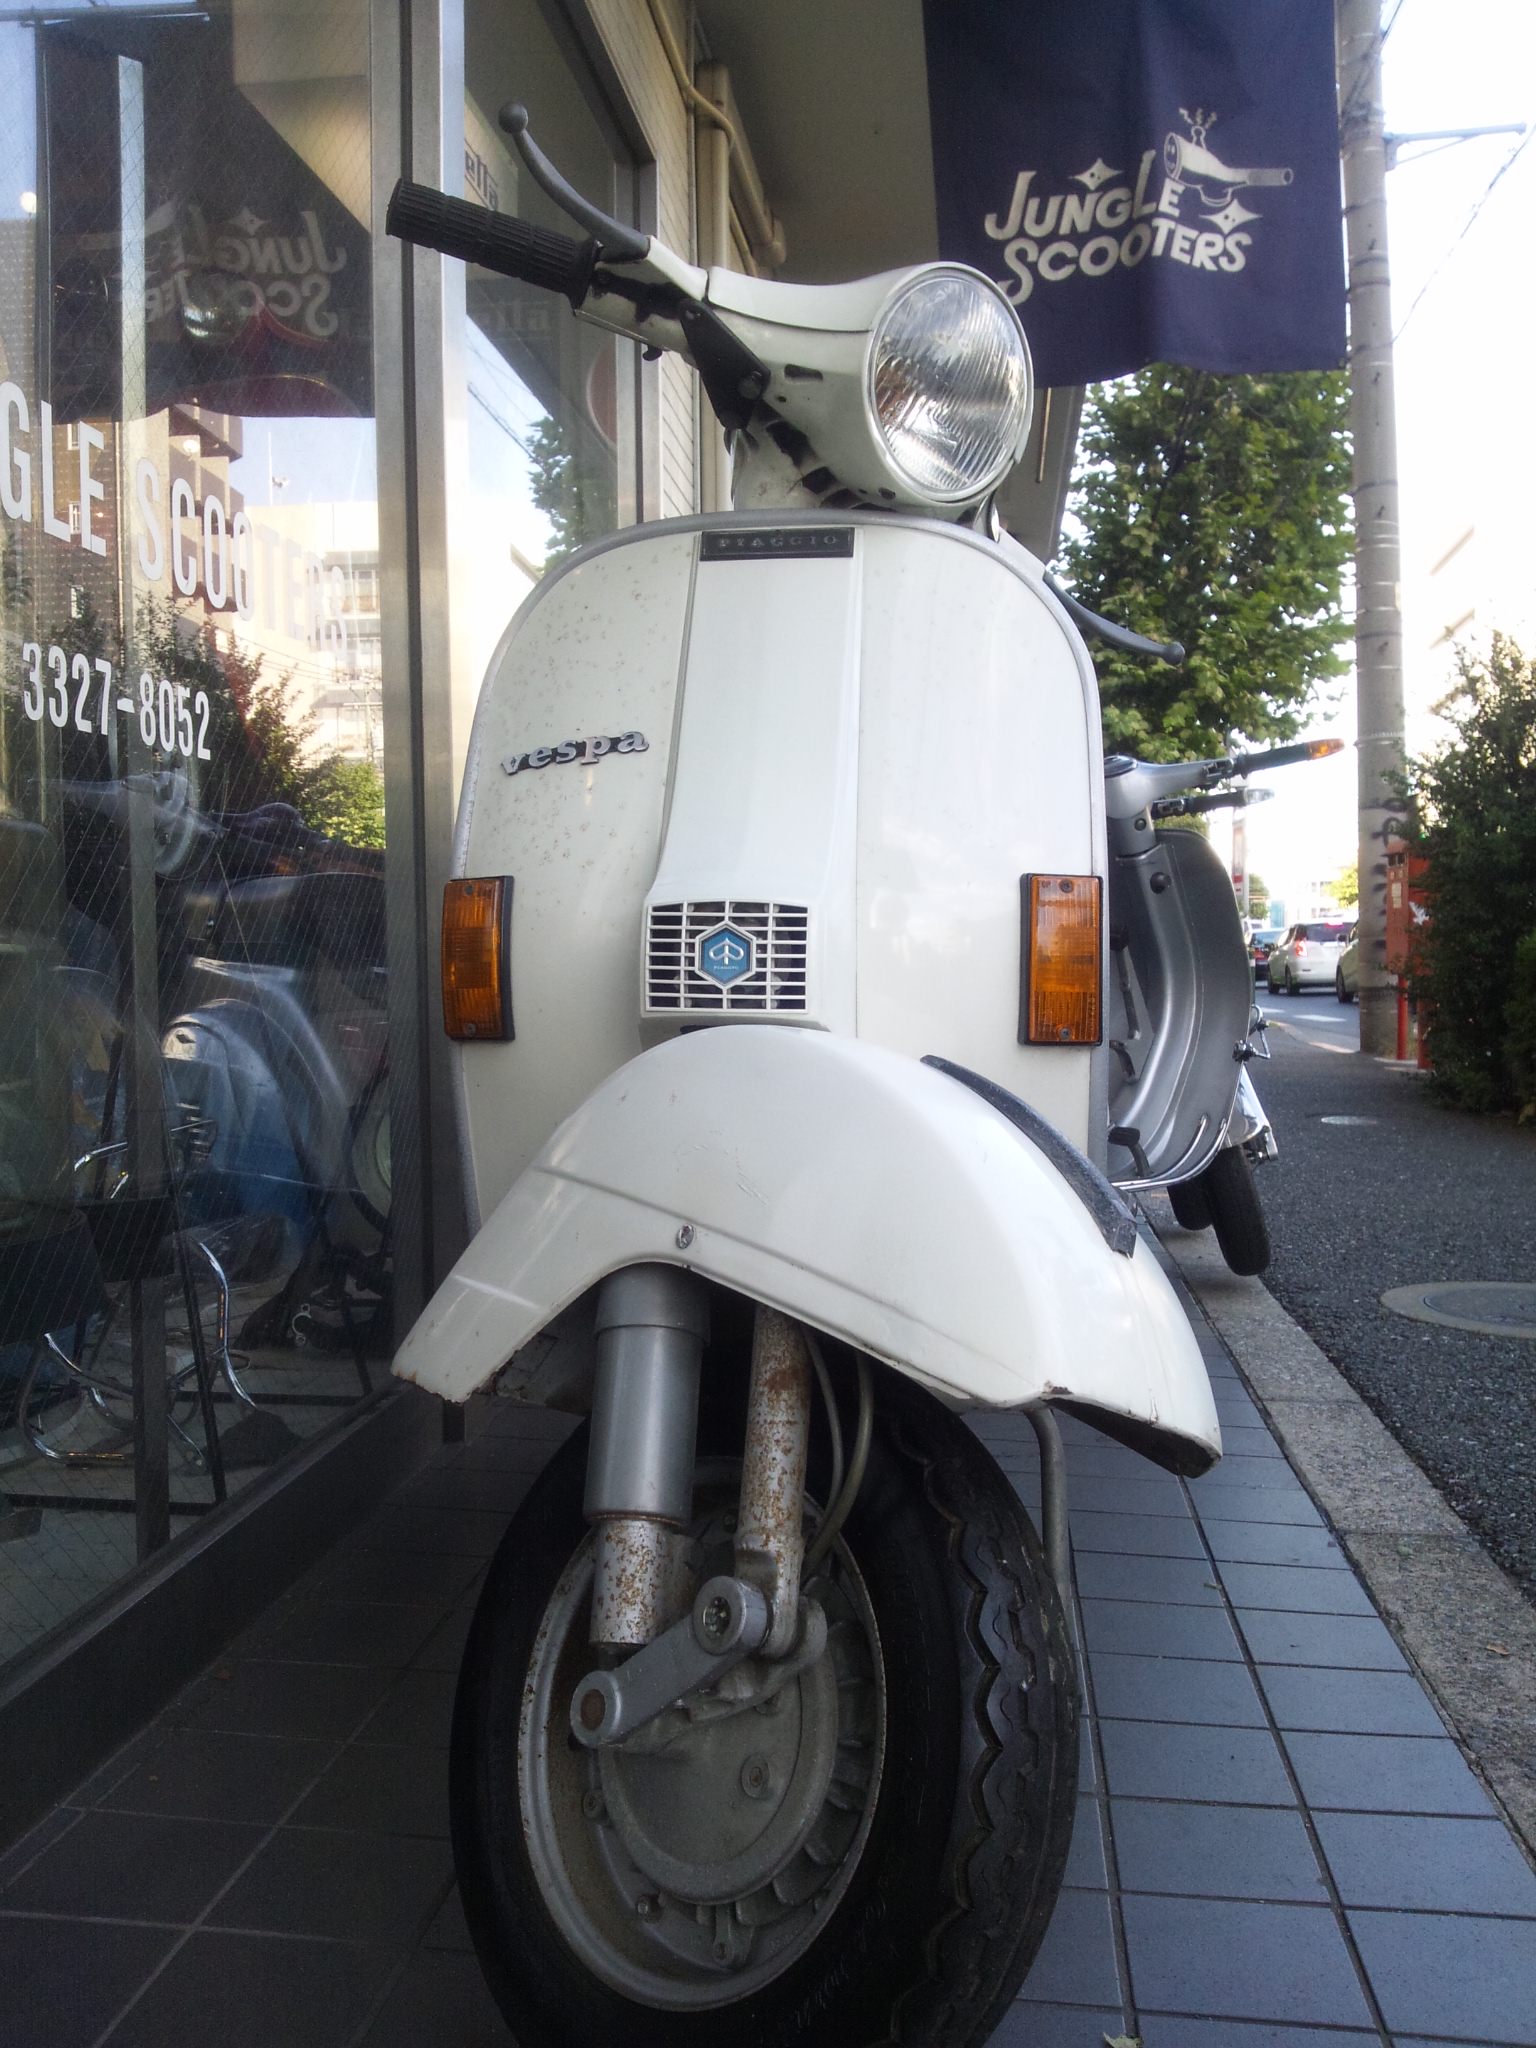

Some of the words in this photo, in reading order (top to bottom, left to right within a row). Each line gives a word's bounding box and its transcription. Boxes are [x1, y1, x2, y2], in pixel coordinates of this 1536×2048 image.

[984, 149, 1186, 240] JUNGLE
[997, 224, 1254, 305] SCOOTERS
[717, 534, 837, 548] PIAGGIO
[22, 642, 212, 761] 3327-8052
[500, 731, 649, 775] vespa
